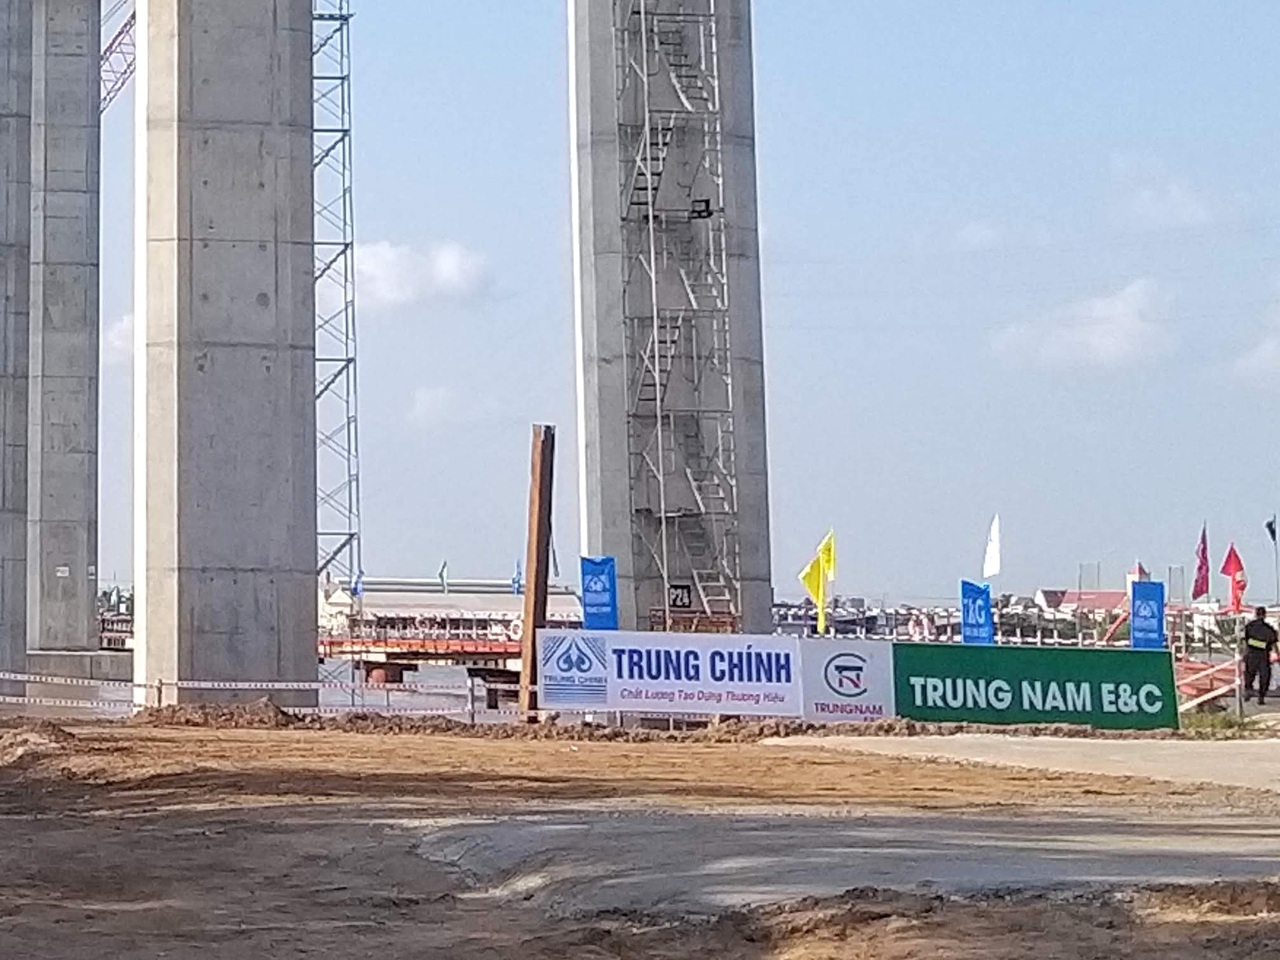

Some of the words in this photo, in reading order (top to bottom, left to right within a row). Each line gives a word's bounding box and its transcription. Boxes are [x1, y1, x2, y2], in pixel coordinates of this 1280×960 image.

[612, 648, 701, 683] TRUNG
[709, 644, 793, 684] CHÍNH
[909, 675, 1013, 710] TRUNG
[1021, 679, 1092, 712] NAM
[1102, 682, 1163, 715] E&C
